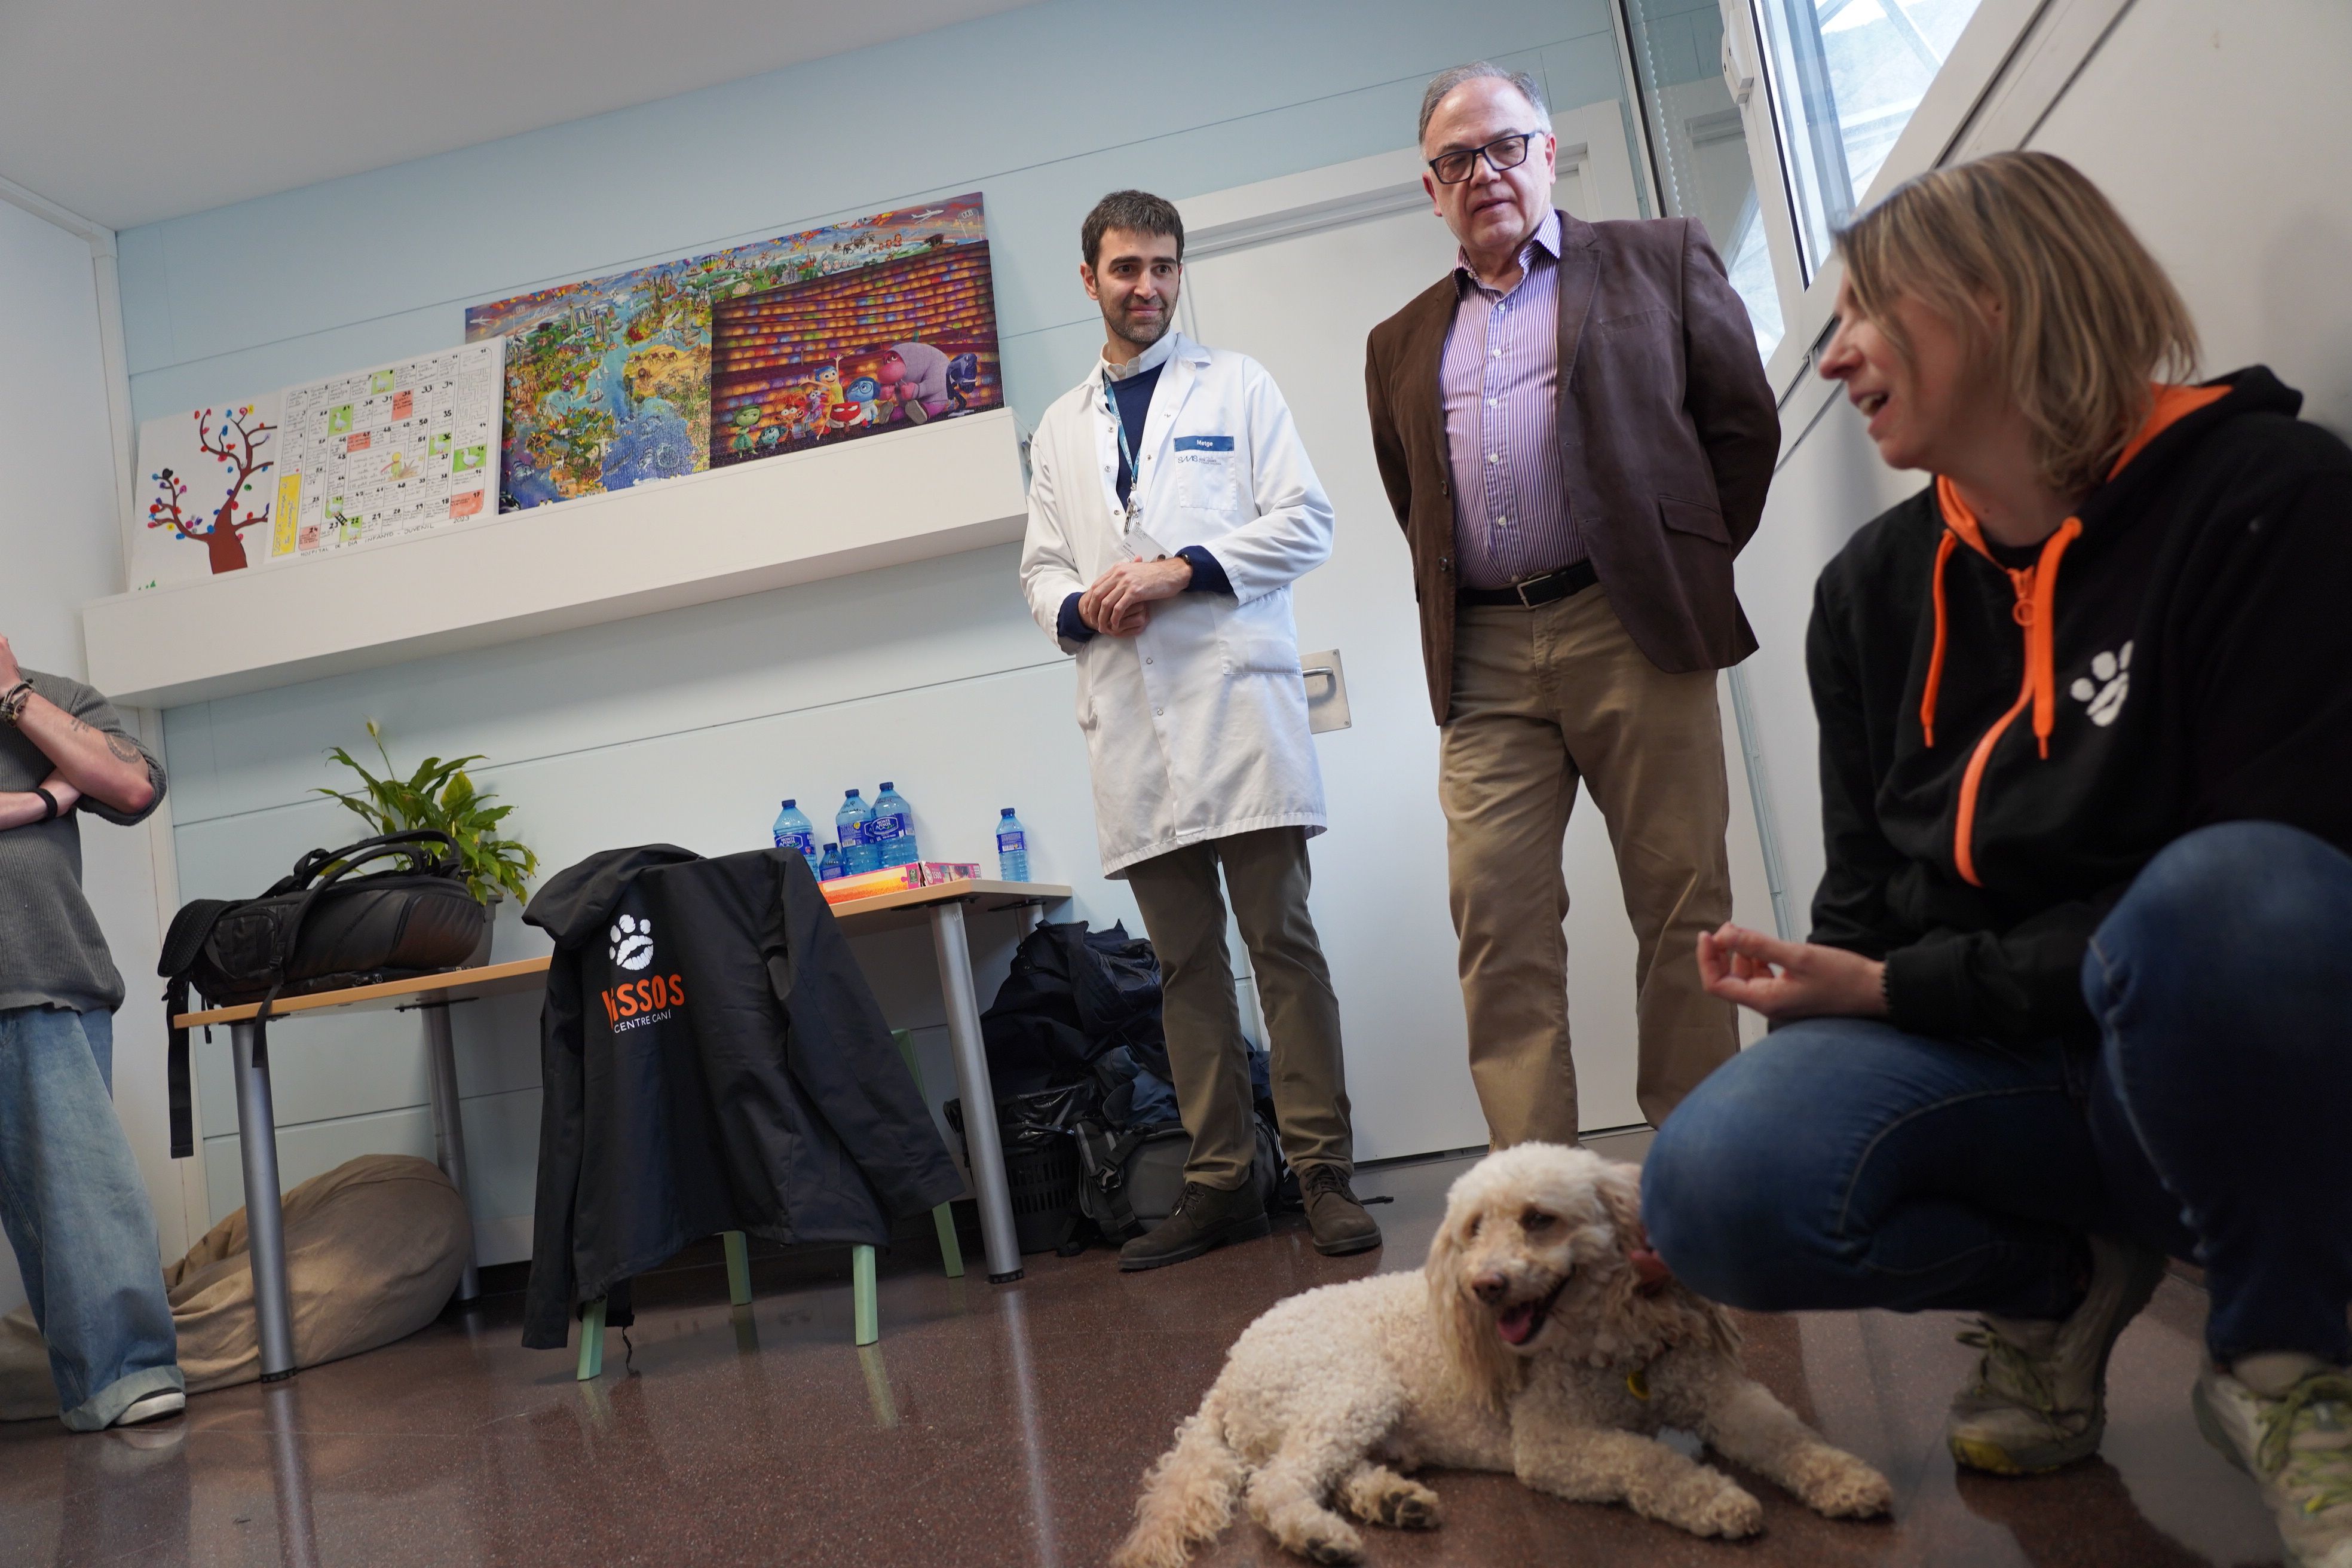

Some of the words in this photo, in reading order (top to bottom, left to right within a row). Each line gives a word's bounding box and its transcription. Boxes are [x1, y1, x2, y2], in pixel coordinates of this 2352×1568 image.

[442, 380, 453, 388] 34
[421, 385, 433, 393] 33
[443, 433, 451, 441] 36
[1196, 439, 1213, 448] Metge
[301, 548, 328, 556] HOSPITAL
[404, 525, 434, 534] JUVENIL
[614, 1016, 651, 1034] CENTRE
